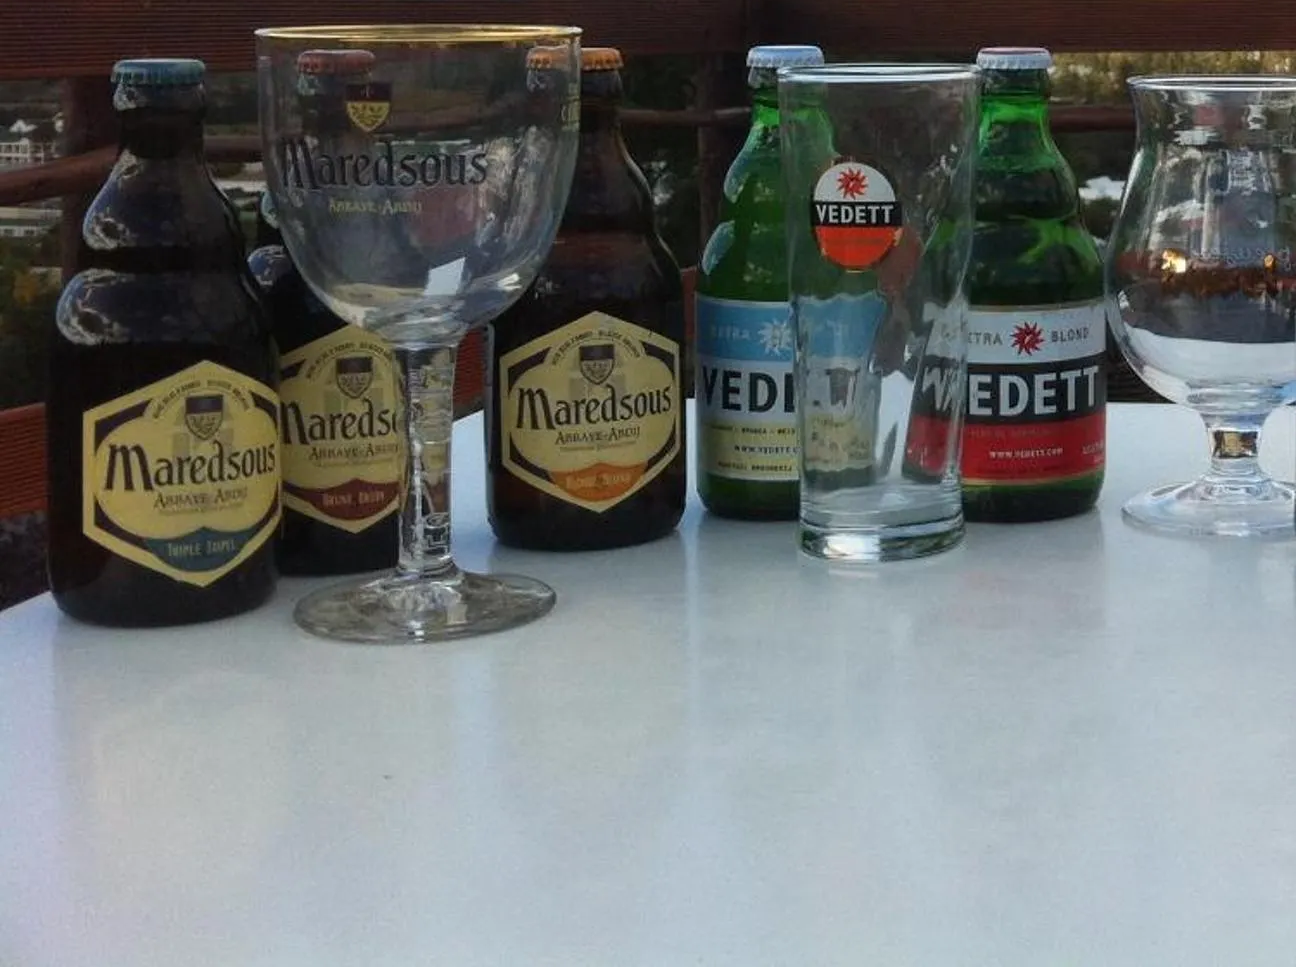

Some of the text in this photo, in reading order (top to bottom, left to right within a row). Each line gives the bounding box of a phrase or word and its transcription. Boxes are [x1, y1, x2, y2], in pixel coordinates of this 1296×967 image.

[282, 137, 489, 190] Maredsous
[815, 204, 894, 224] VEDETT
[1052, 328, 1089, 343] BLOND
[515, 384, 672, 431] Maredsous
[104, 440, 276, 492] Maredsous
